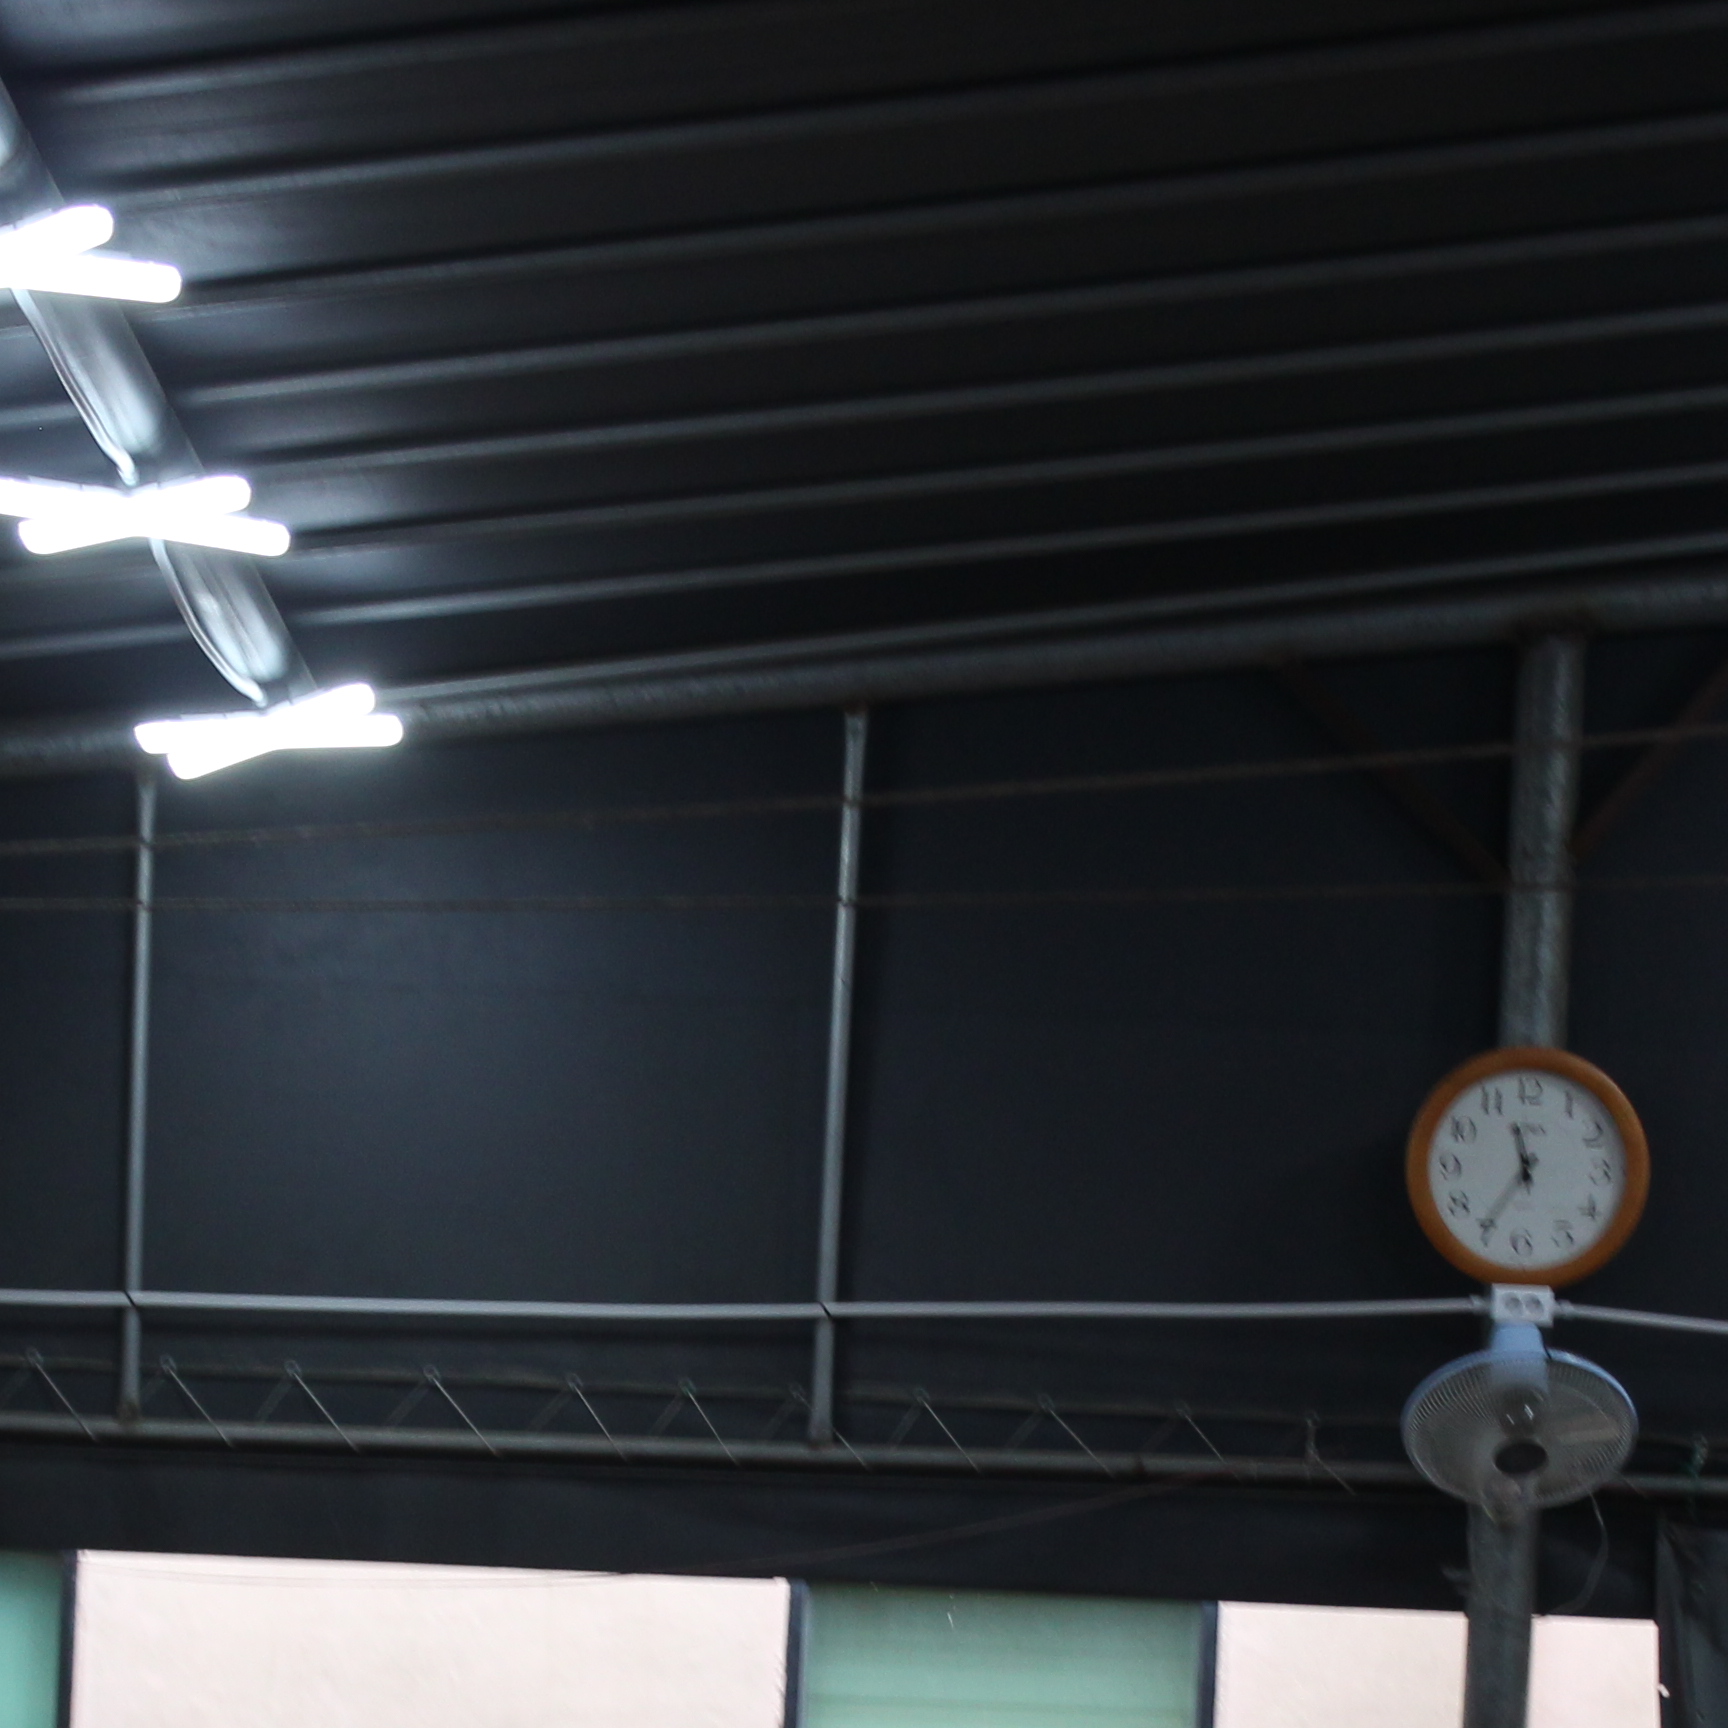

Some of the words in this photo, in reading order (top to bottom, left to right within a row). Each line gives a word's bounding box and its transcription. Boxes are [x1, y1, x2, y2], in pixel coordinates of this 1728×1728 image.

[1481, 1084, 1503, 1116] 11
[1518, 1075, 1543, 1105] 12
[1450, 1115, 1476, 1143] 10
[1582, 1119, 1604, 1148] 2
[1438, 1152, 1462, 1180] 9
[1587, 1158, 1612, 1187] 3
[1447, 1189, 1470, 1217] 8
[1575, 1194, 1599, 1221] 4
[1509, 1228, 1533, 1256] 6
[1550, 1218, 1574, 1248] 5
